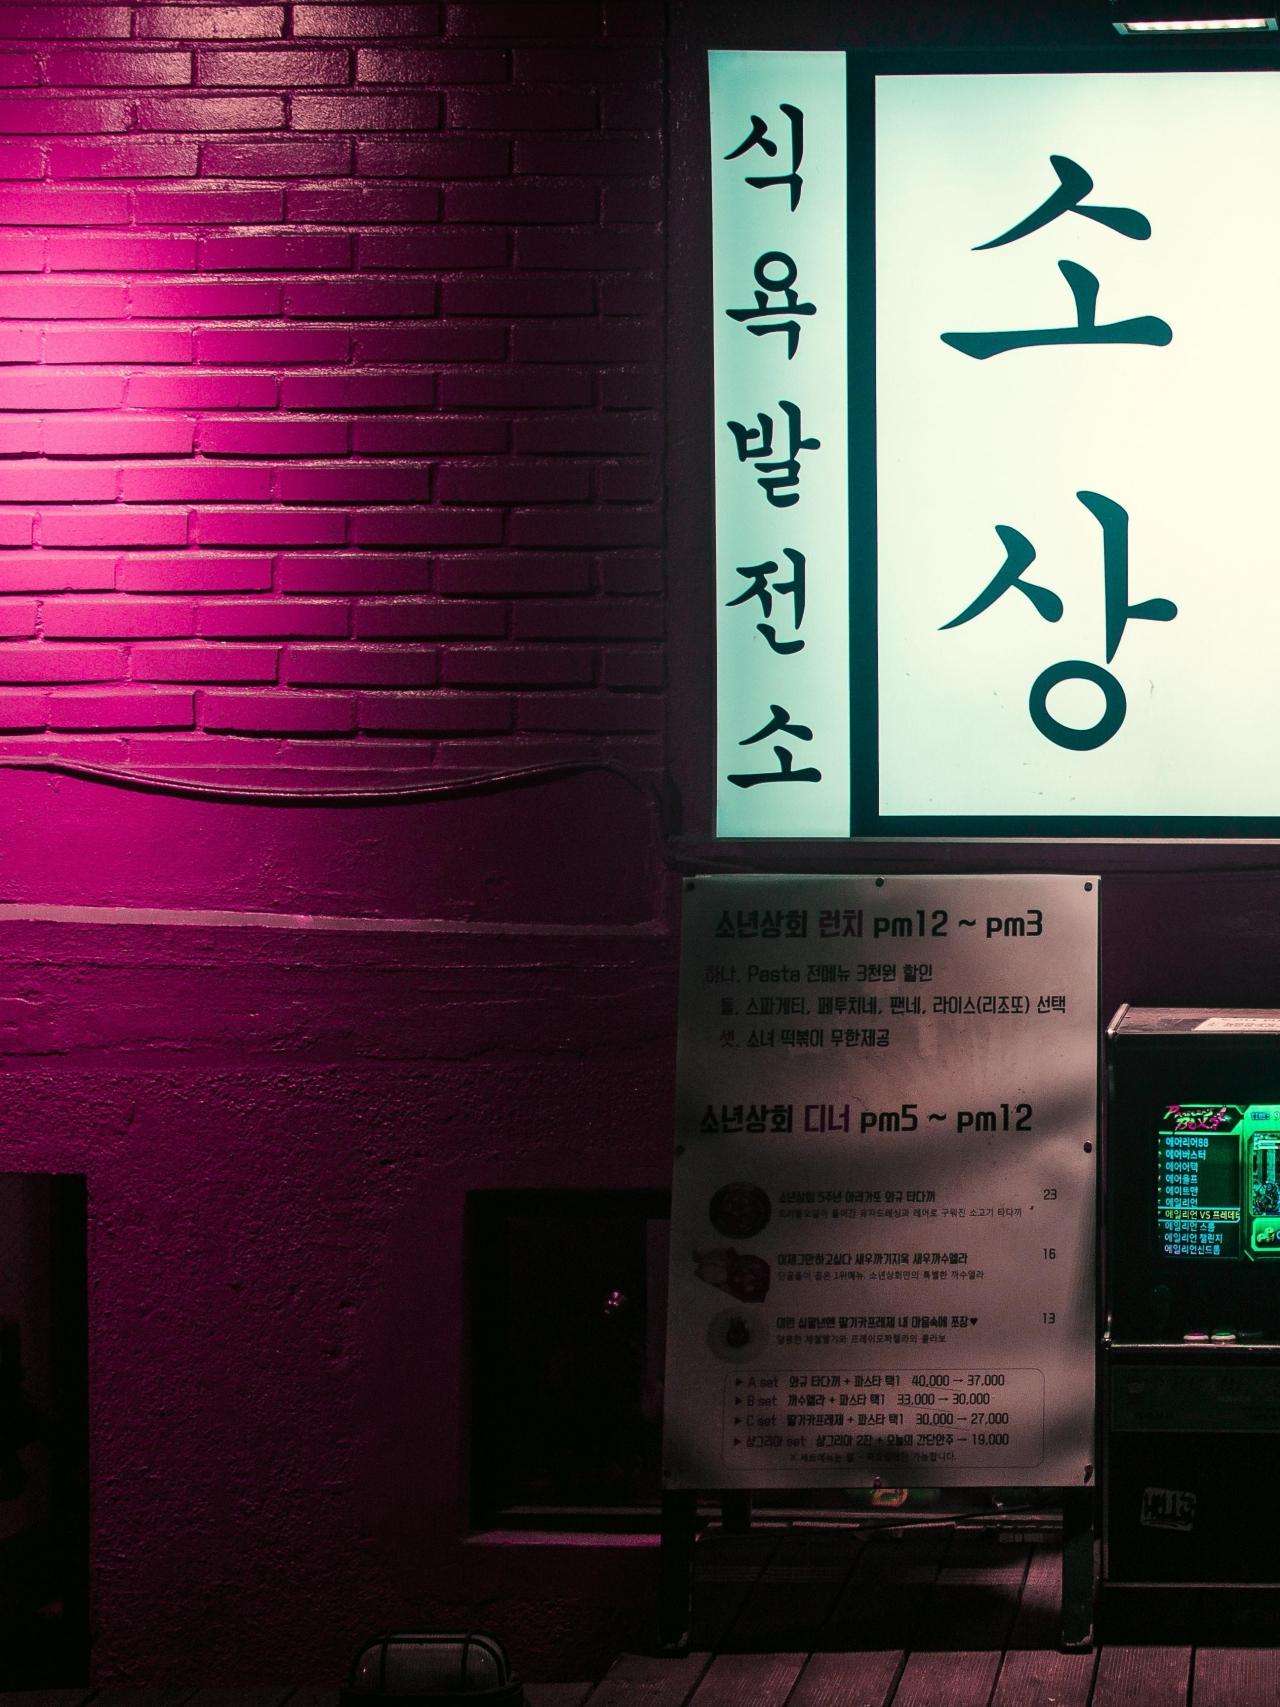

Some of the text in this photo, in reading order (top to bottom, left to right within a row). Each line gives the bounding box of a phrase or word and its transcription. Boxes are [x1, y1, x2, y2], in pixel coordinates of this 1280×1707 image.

[723, 103, 822, 789] 식욕발전소
[714, 909, 808, 938] 소년상회
[819, 909, 863, 938] 런치
[873, 909, 948, 938] pm12
[986, 909, 1043, 938] pm3
[704, 963, 933, 983] 하나. Pasta 전메뉴 3천원 할인
[720, 997, 739, 1015] 둘.
[745, 996, 811, 1015] 스파게티,
[932, 995, 1030, 1014] 라이스(리조또)
[1037, 995, 1066, 1014] 선택
[719, 1028, 890, 1047] 셋. 소녀 떡볶이 무한제공
[699, 1104, 793, 1134] 소년상회
[804, 1104, 850, 1133] 디너
[860, 1104, 918, 1134] pm5
[957, 1103, 1033, 1133] pm12
[1165, 1137, 1209, 1147] 에어리어88
[1165, 1149, 1206, 1160] 에어버스터
[1165, 1174, 1198, 1184] 에어울프
[885, 1191, 903, 1202] 와규
[906, 1191, 936, 1202] 타다끼
[1043, 1188, 1057, 1200] 23
[1165, 1198, 1197, 1208] 에일리언
[969, 1208, 994, 1217] 소고기
[997, 1207, 1022, 1217] 타다끼
[1164, 1210, 1198, 1220] 에일리언
[1200, 1211, 1211, 1219] VS
[1164, 1221, 1197, 1231] 에일리언
[1164, 1233, 1197, 1243] 에일리언
[1043, 1248, 1056, 1260] 16
[898, 1316, 908, 1328] 내
[911, 1316, 948, 1328] 마음속에
[1043, 1313, 1056, 1324] 13
[747, 1376, 756, 1388] A
[760, 1376, 779, 1388] set
[789, 1375, 808, 1388] 와규
[810, 1375, 841, 1388] 타다끼
[854, 1375, 881, 1388] 파스타
[911, 1374, 950, 1387] 40,000
[967, 1374, 1005, 1386] 37,000
[747, 1395, 755, 1406] B
[758, 1395, 778, 1406] set
[839, 1394, 866, 1406] 파스타
[897, 1393, 935, 1405] 33,000
[952, 1393, 990, 1405] 30,000
[746, 1415, 754, 1426] C
[757, 1415, 777, 1426] set
[858, 1414, 886, 1425] 파스타
[916, 1413, 953, 1425] 30,000
[970, 1412, 1009, 1425] 27,000
[786, 1436, 807, 1446] set
[856, 1434, 872, 1446] 2잔
[916, 1433, 954, 1446] 간단안주
[972, 1433, 1009, 1445] 19,000
